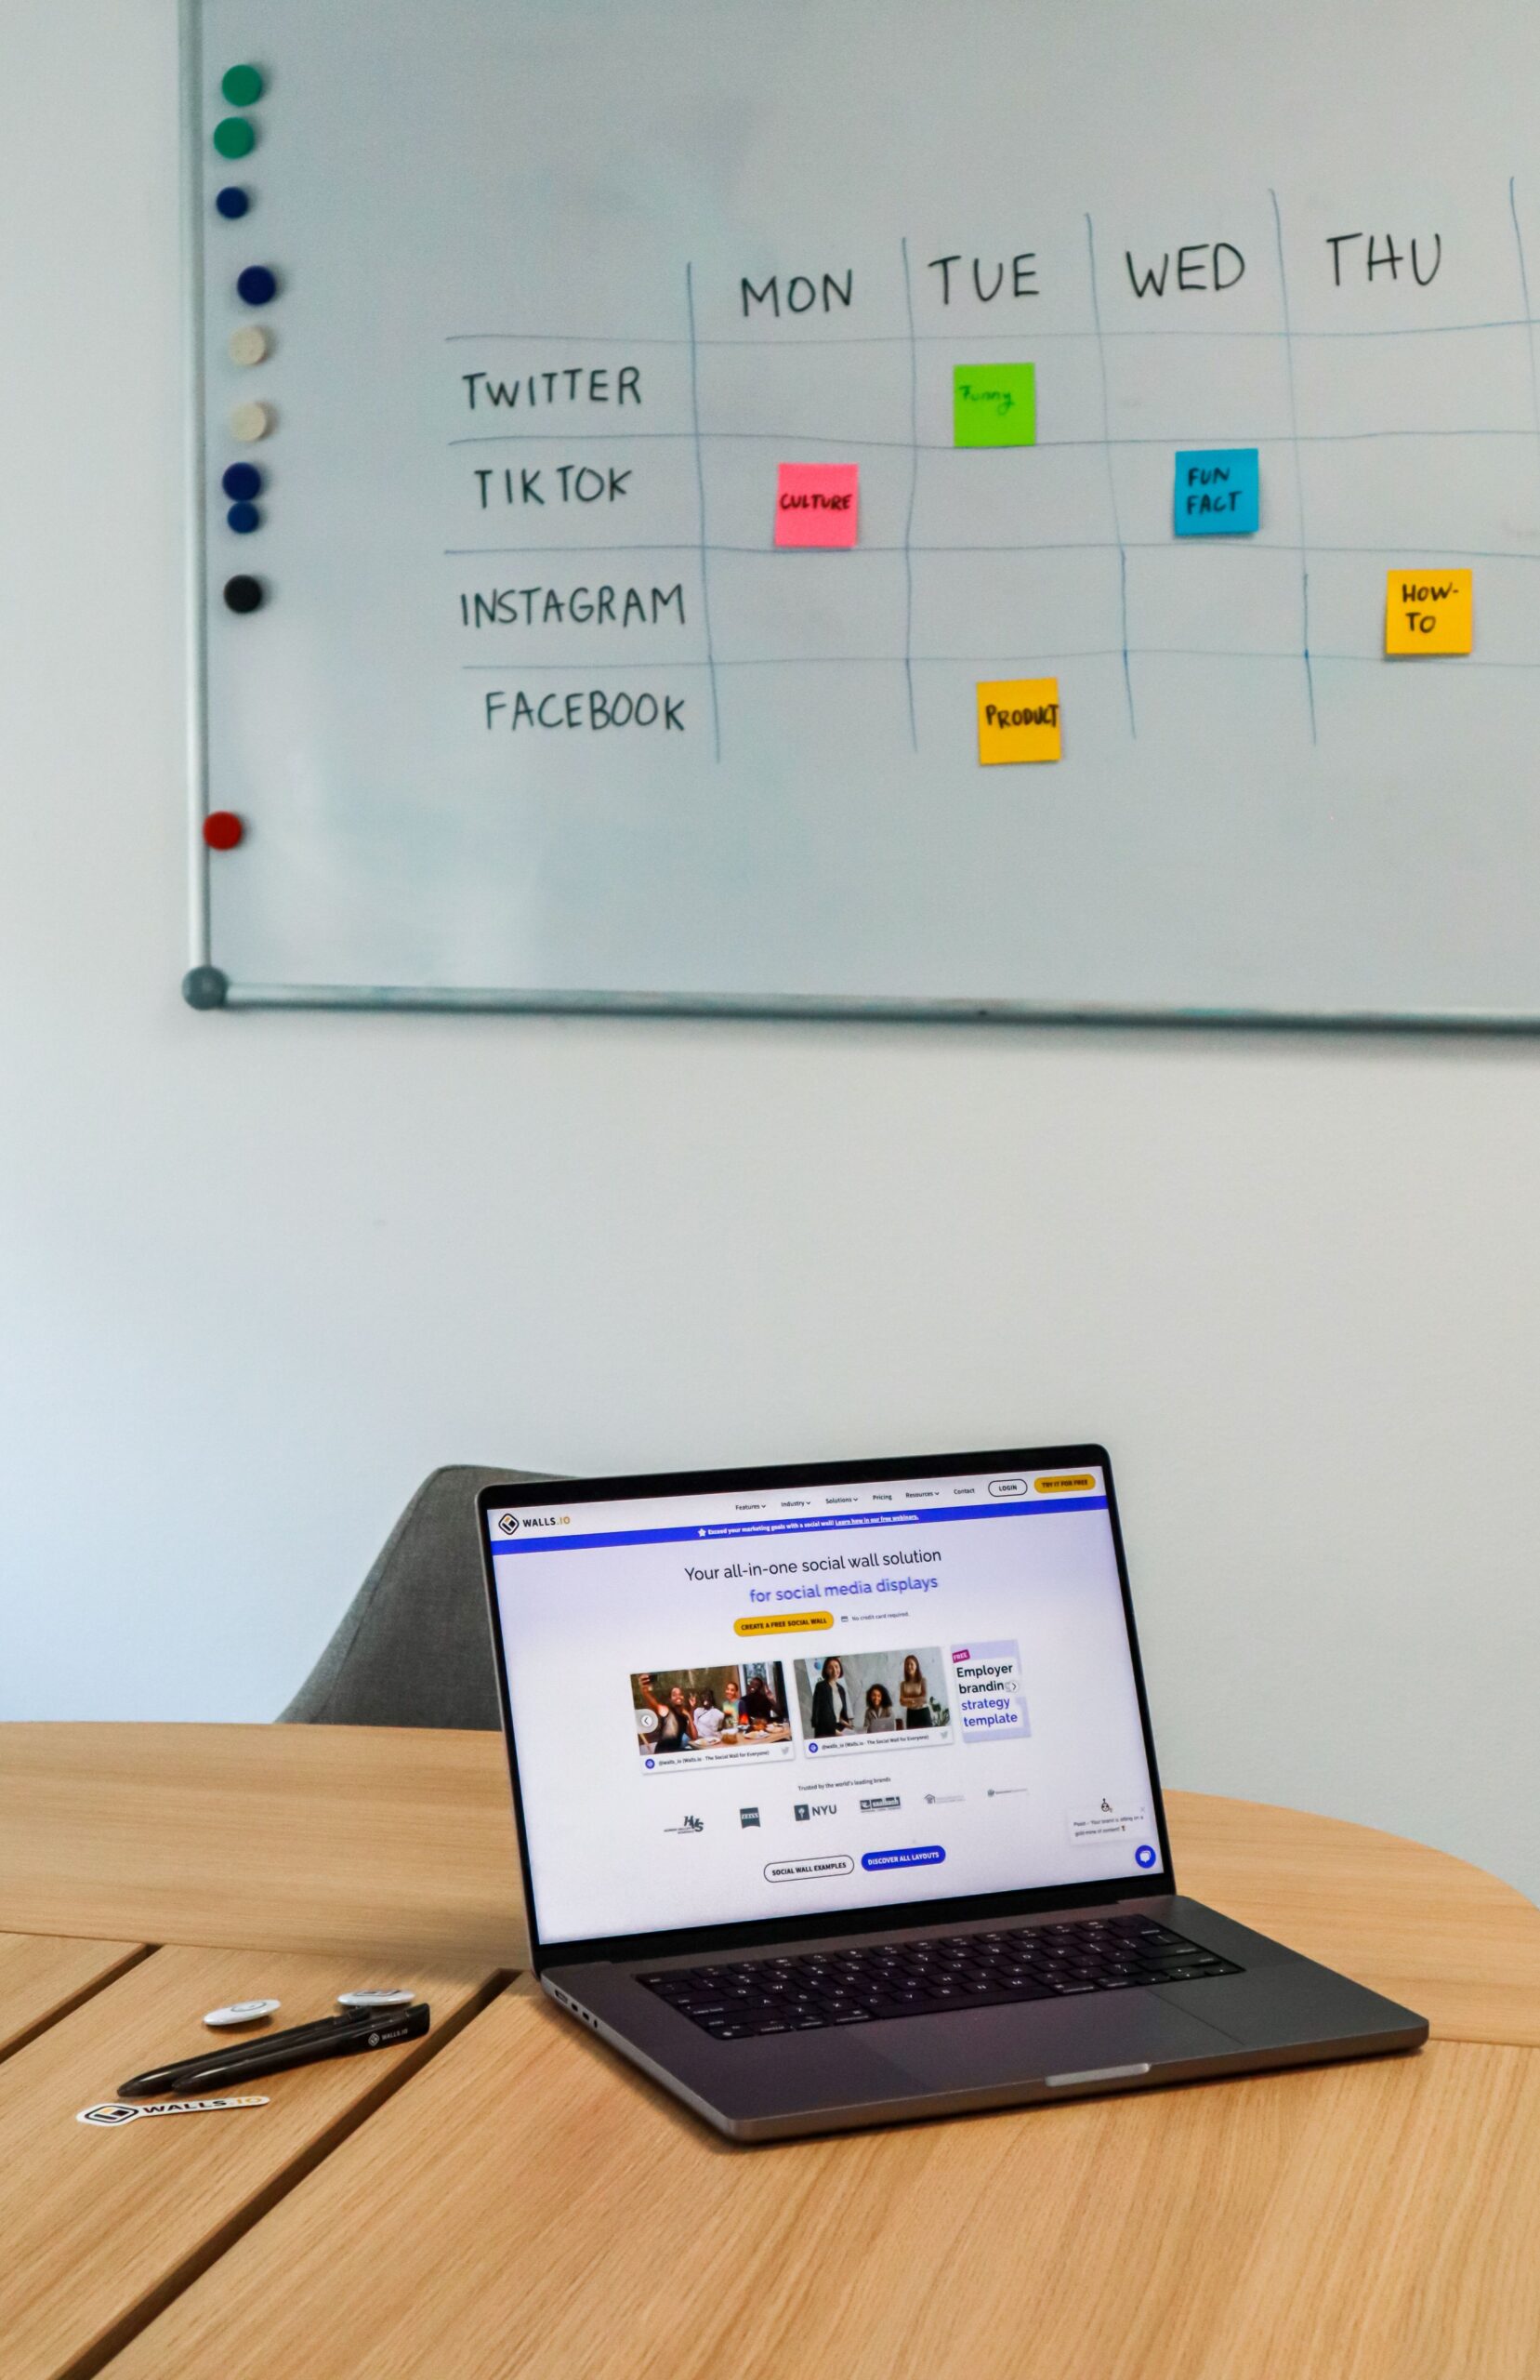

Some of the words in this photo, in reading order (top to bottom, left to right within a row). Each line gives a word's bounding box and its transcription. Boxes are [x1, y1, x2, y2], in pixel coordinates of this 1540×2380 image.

[742, 270, 852, 317] MON
[928, 254, 1039, 304] TUE
[1126, 243, 1244, 298] WED
[1326, 233, 1441, 285] THU
[463, 366, 641, 409] TWITTER
[1188, 467, 1231, 487] FUN
[780, 493, 852, 510] CULTURE
[1187, 490, 1243, 515] FACT
[1402, 581, 1459, 602] HOW-
[461, 584, 685, 628] INSTAGRAM
[1405, 612, 1436, 633] TO
[485, 692, 685, 731] FACEBOOK
[985, 704, 1060, 729] PRODUCT
[905, 1490, 933, 1499] Resources
[522, 1516, 571, 1527] WALLS.IO
[684, 1567, 719, 1581] Your
[724, 1562, 798, 1579] all-in-one
[801, 1555, 846, 1572] social
[848, 1553, 880, 1568] wall
[882, 1549, 942, 1566] solution
[750, 1588, 771, 1603] for
[775, 1583, 822, 1601] social
[824, 1580, 873, 1597] media
[875, 1576, 939, 1594] displays
[770, 1620, 786, 1629] FREE
[787, 1619, 809, 1627] SOCIAL
[953, 1652, 968, 1661] FREE
[956, 1664, 1013, 1679] Employer
[961, 1698, 1010, 1711] strategy
[964, 1712, 1018, 1727] template
[811, 1804, 837, 1817] NYU
[867, 1857, 899, 1866] DISCOVER
[912, 1851, 940, 1861] LAYOUTS
[771, 1868, 794, 1876] SOCIAL
[796, 1865, 813, 1874] WALL
[814, 1862, 847, 1872] EXAMPLES
